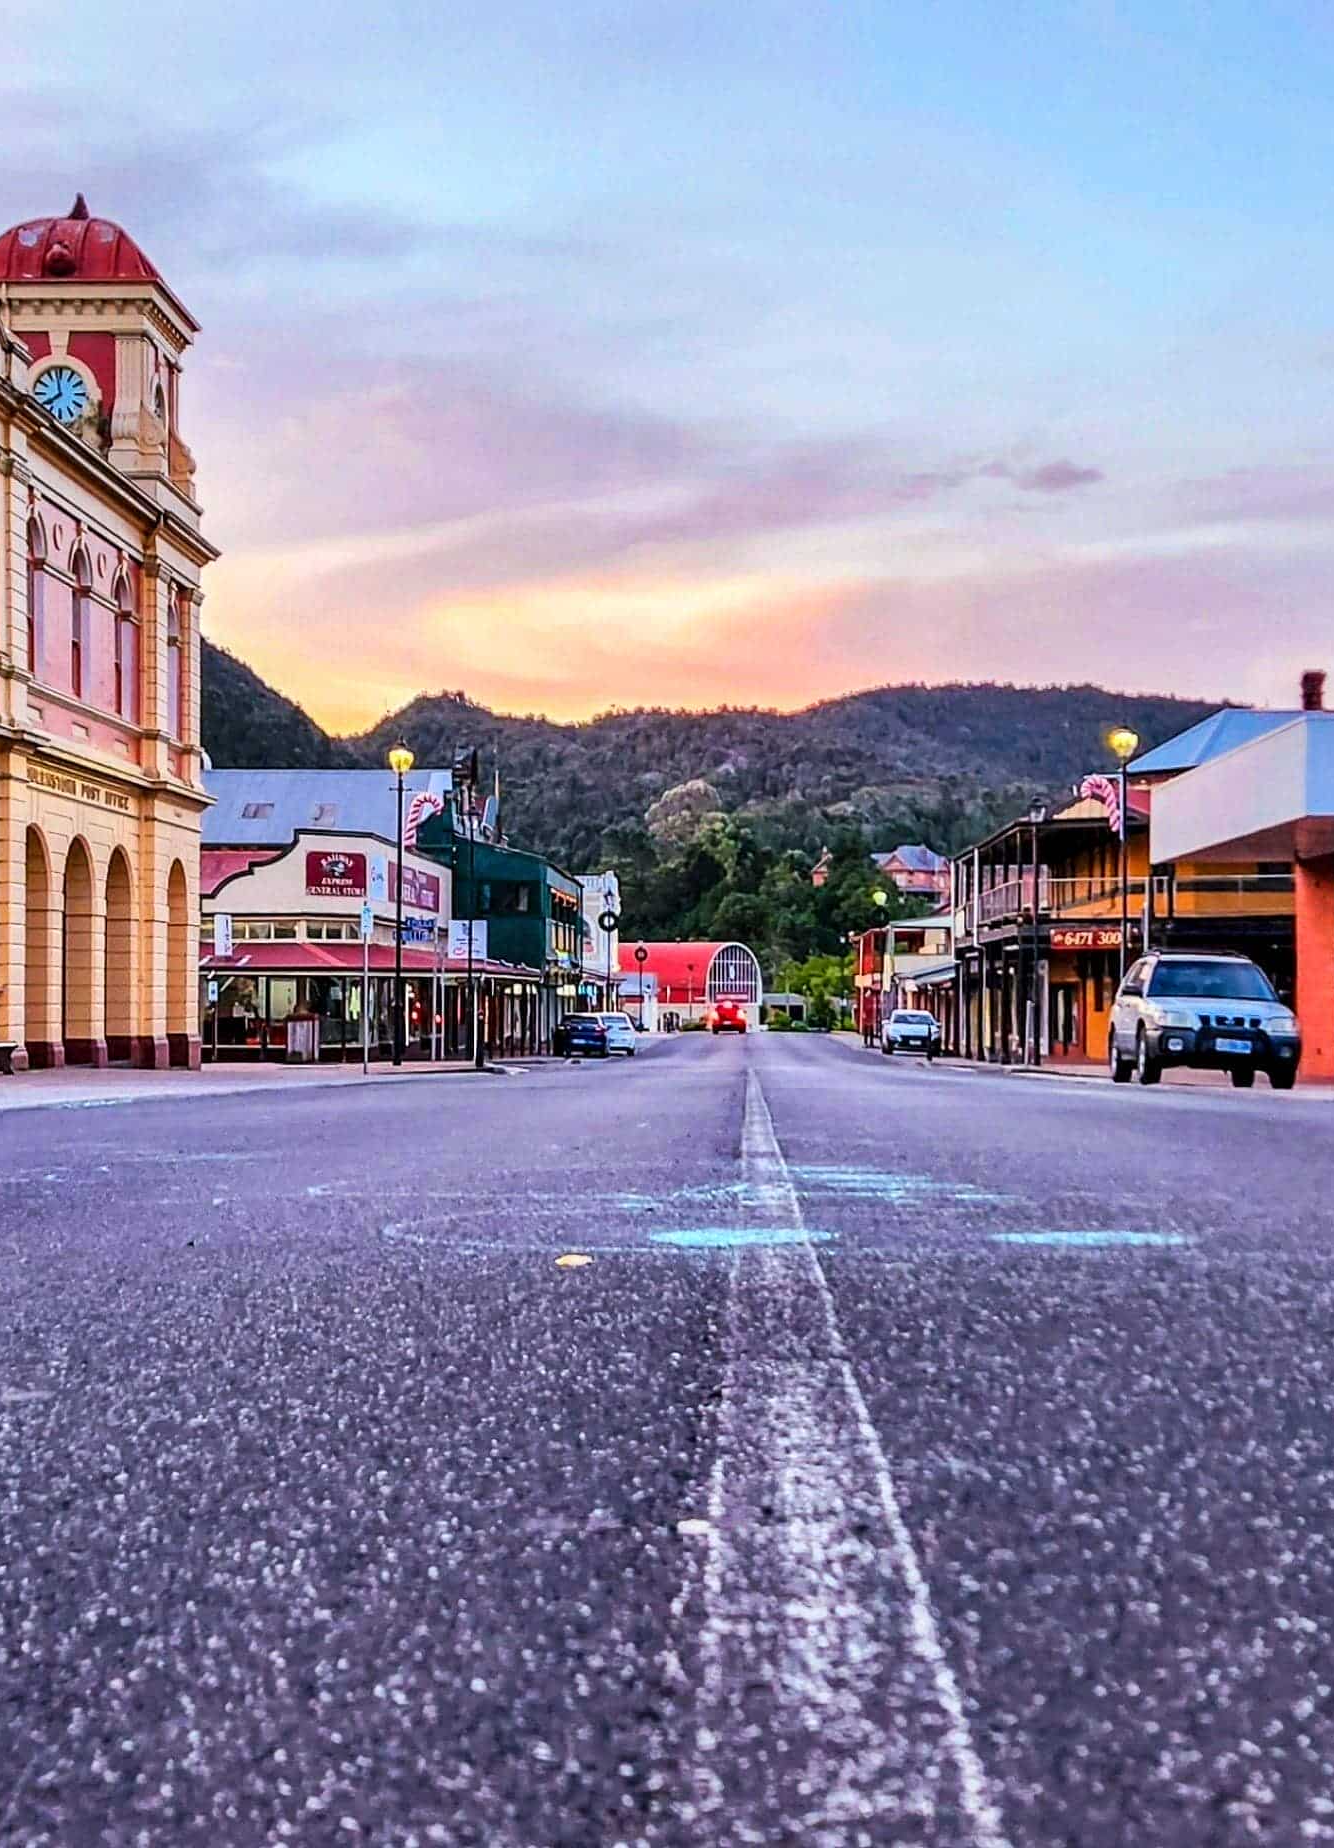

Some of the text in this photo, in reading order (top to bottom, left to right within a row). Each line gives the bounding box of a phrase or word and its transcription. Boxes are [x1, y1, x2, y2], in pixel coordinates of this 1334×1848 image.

[81, 783, 100, 802] POST
[1064, 931, 1094, 945] 6471
[1096, 931, 1123, 945] 300
